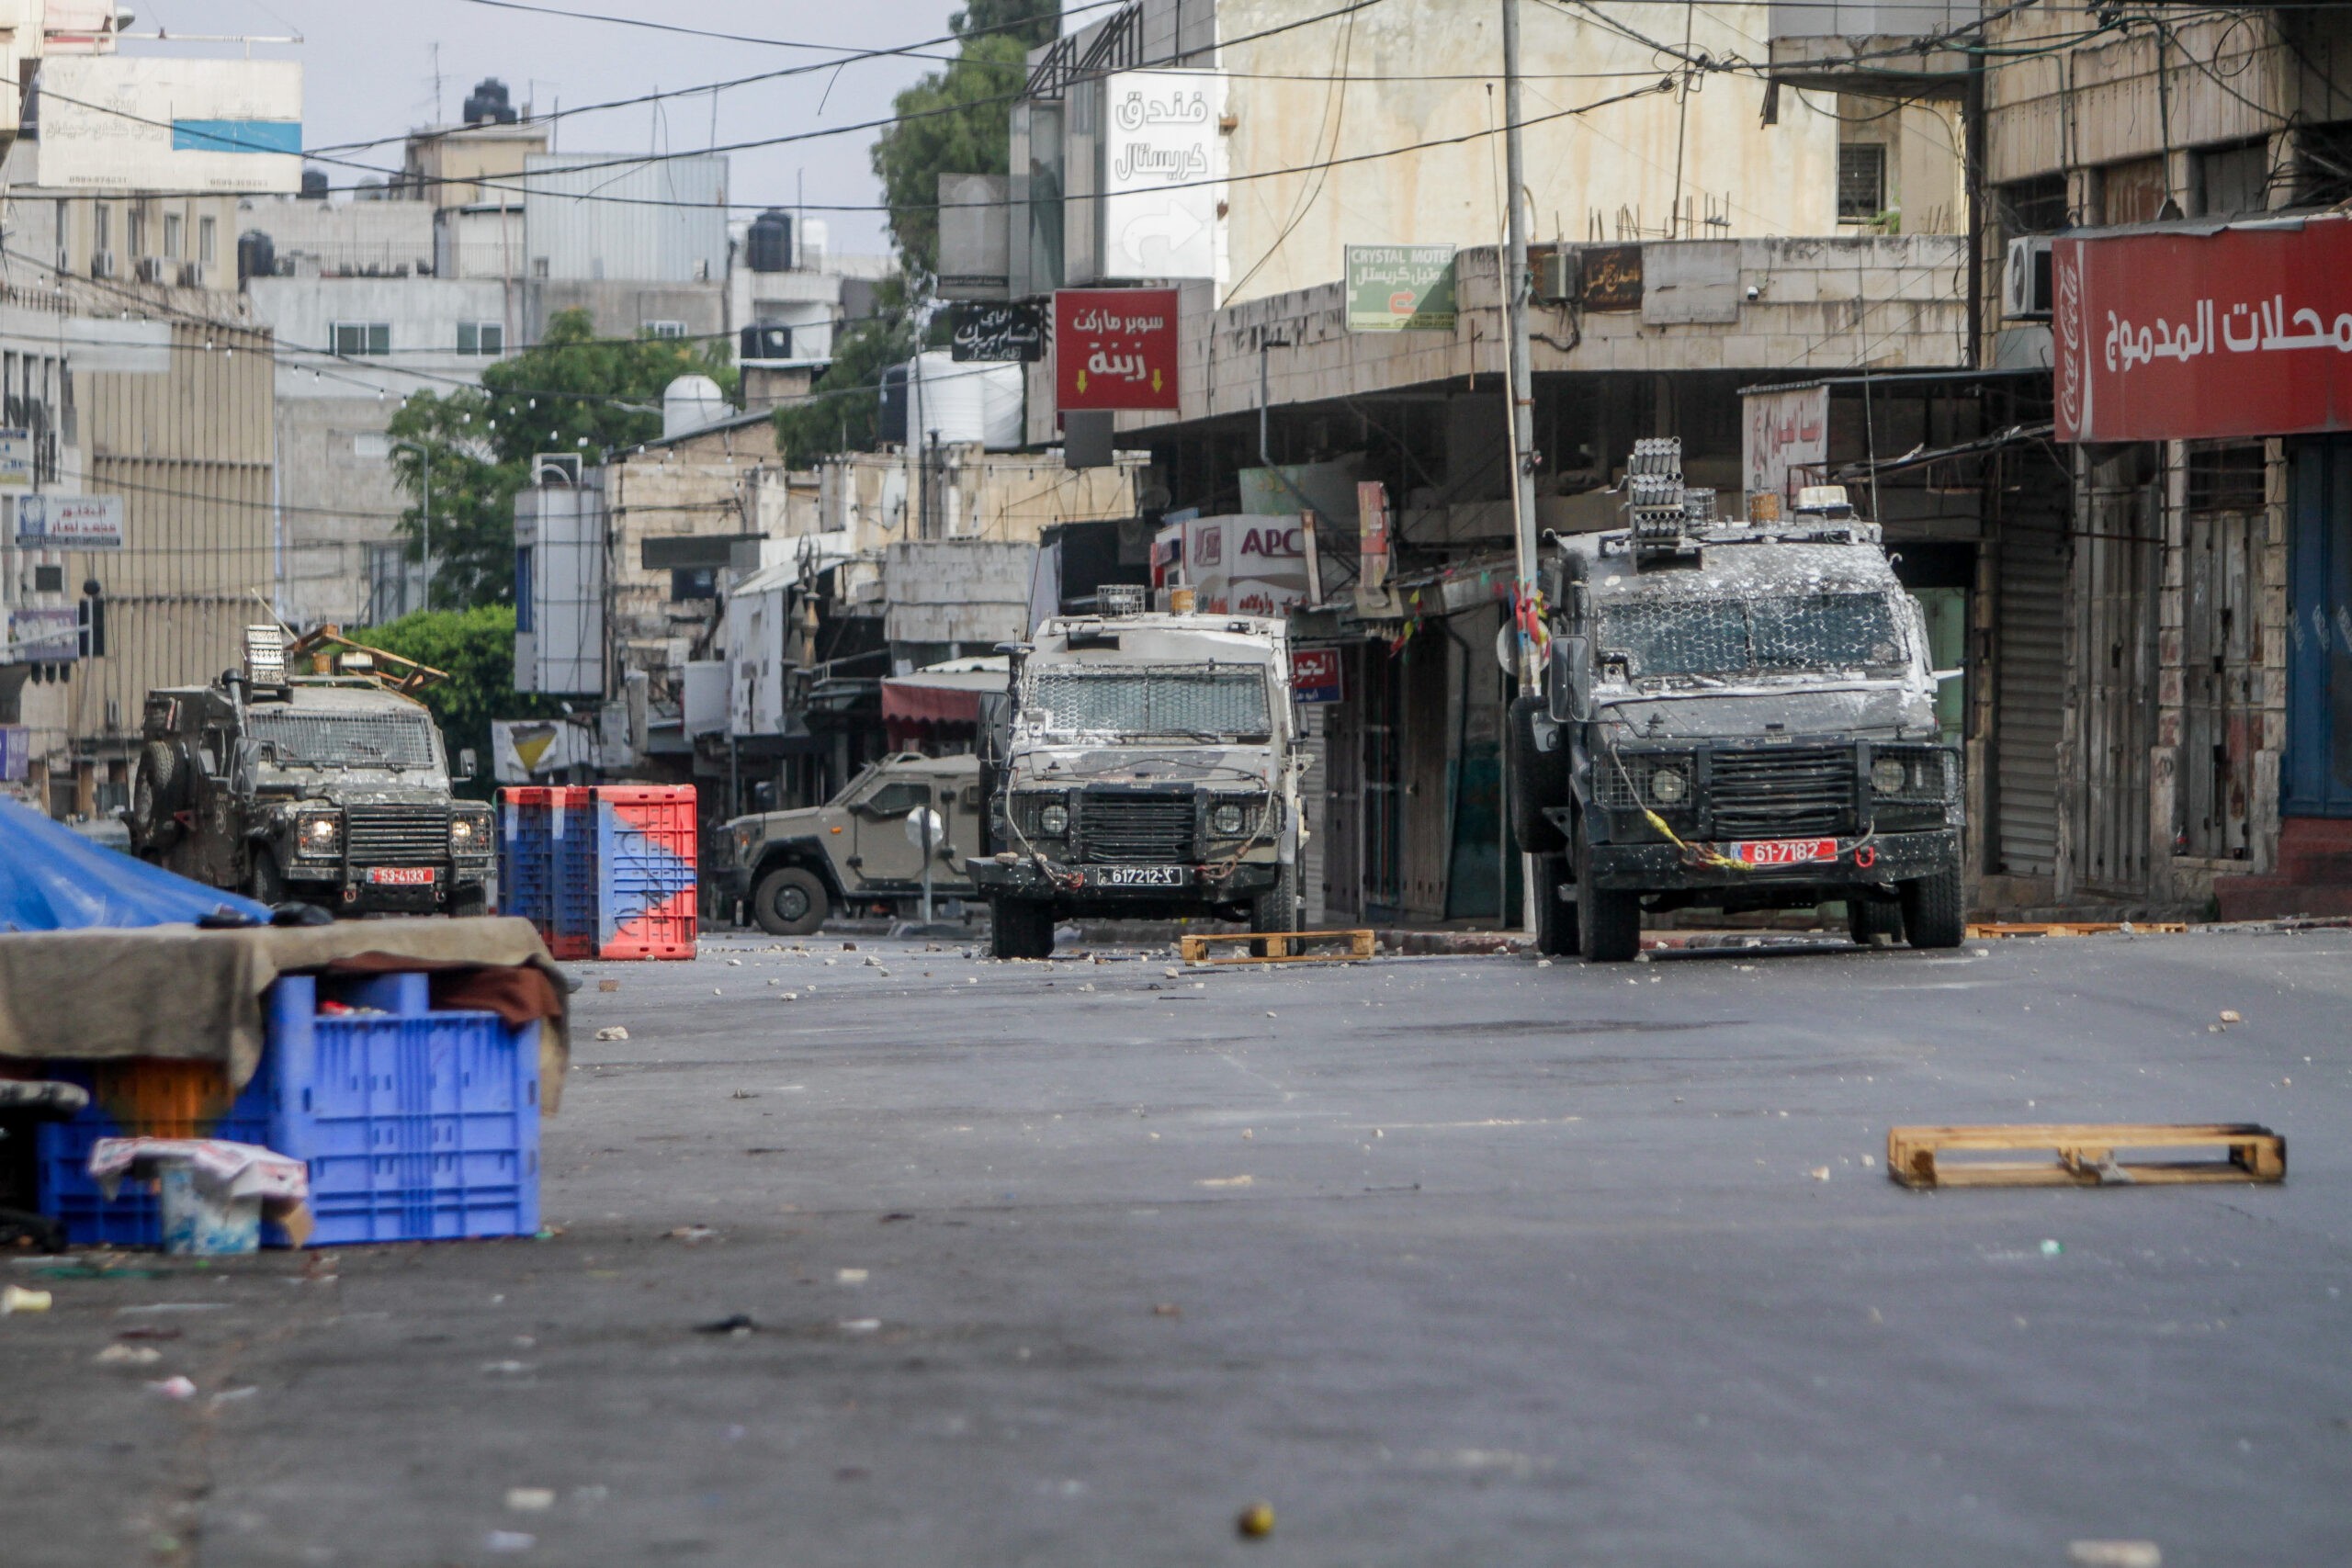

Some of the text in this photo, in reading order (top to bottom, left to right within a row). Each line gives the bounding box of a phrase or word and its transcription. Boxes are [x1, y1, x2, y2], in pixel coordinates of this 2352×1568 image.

[1116, 91, 1208, 130] فندق
[1115, 143, 1207, 181] كريستال
[1351, 249, 1406, 265] CRYSTAL
[1355, 266, 1409, 287] كريستال
[1073, 309, 1164, 334] سوبر ماركت
[2105, 294, 2352, 373] محلات المدموج
[2059, 255, 2080, 433] Coca-Cola
[1088, 342, 1148, 382] زينة
[1241, 528, 1301, 555] APC
[1295, 653, 1335, 683] الجو
[1754, 842, 1819, 862] 61-7182
